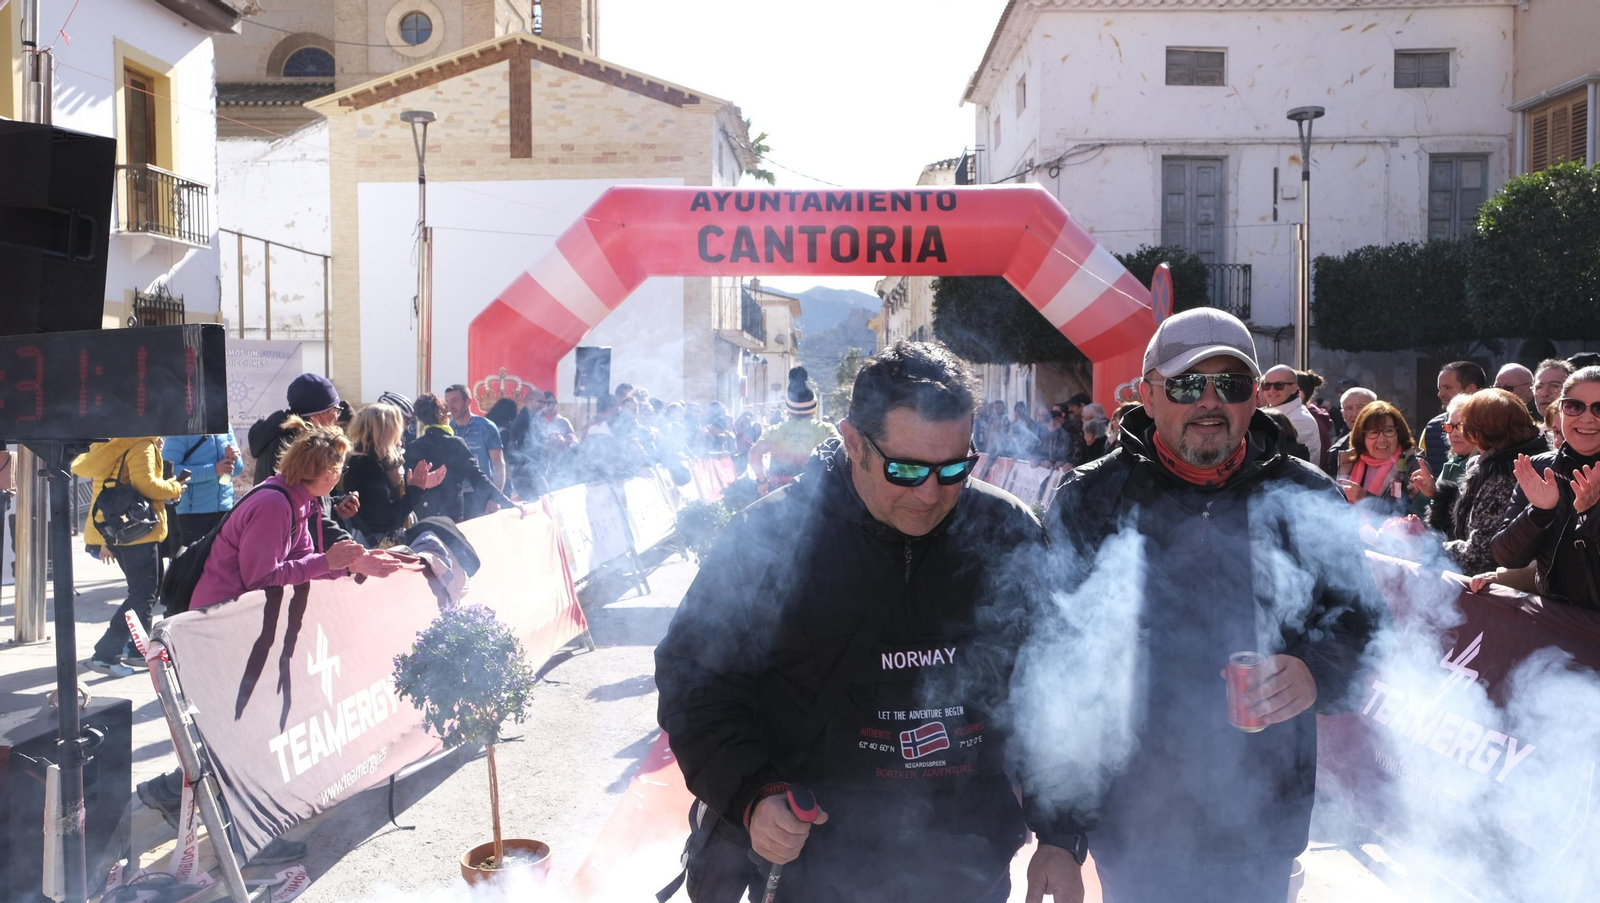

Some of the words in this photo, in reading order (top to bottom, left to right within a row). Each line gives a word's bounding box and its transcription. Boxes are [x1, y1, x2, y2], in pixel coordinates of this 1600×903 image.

[690, 190, 957, 212] AYUNTAMIENTO
[697, 224, 947, 263] CANTORIA
[881, 647, 956, 670] NORWAY
[878, 711, 890, 720] LET
[894, 710, 906, 720] THE
[909, 708, 942, 720] ADVENTURE
[944, 706, 964, 717] BEGIN
[268, 673, 399, 784] TEAMERGY
[861, 727, 892, 740] AUTHENTIC
[1362, 679, 1536, 783] TEAMERGY
[876, 768, 917, 779] BORIKEN
[922, 763, 973, 777] ADVENTURE
